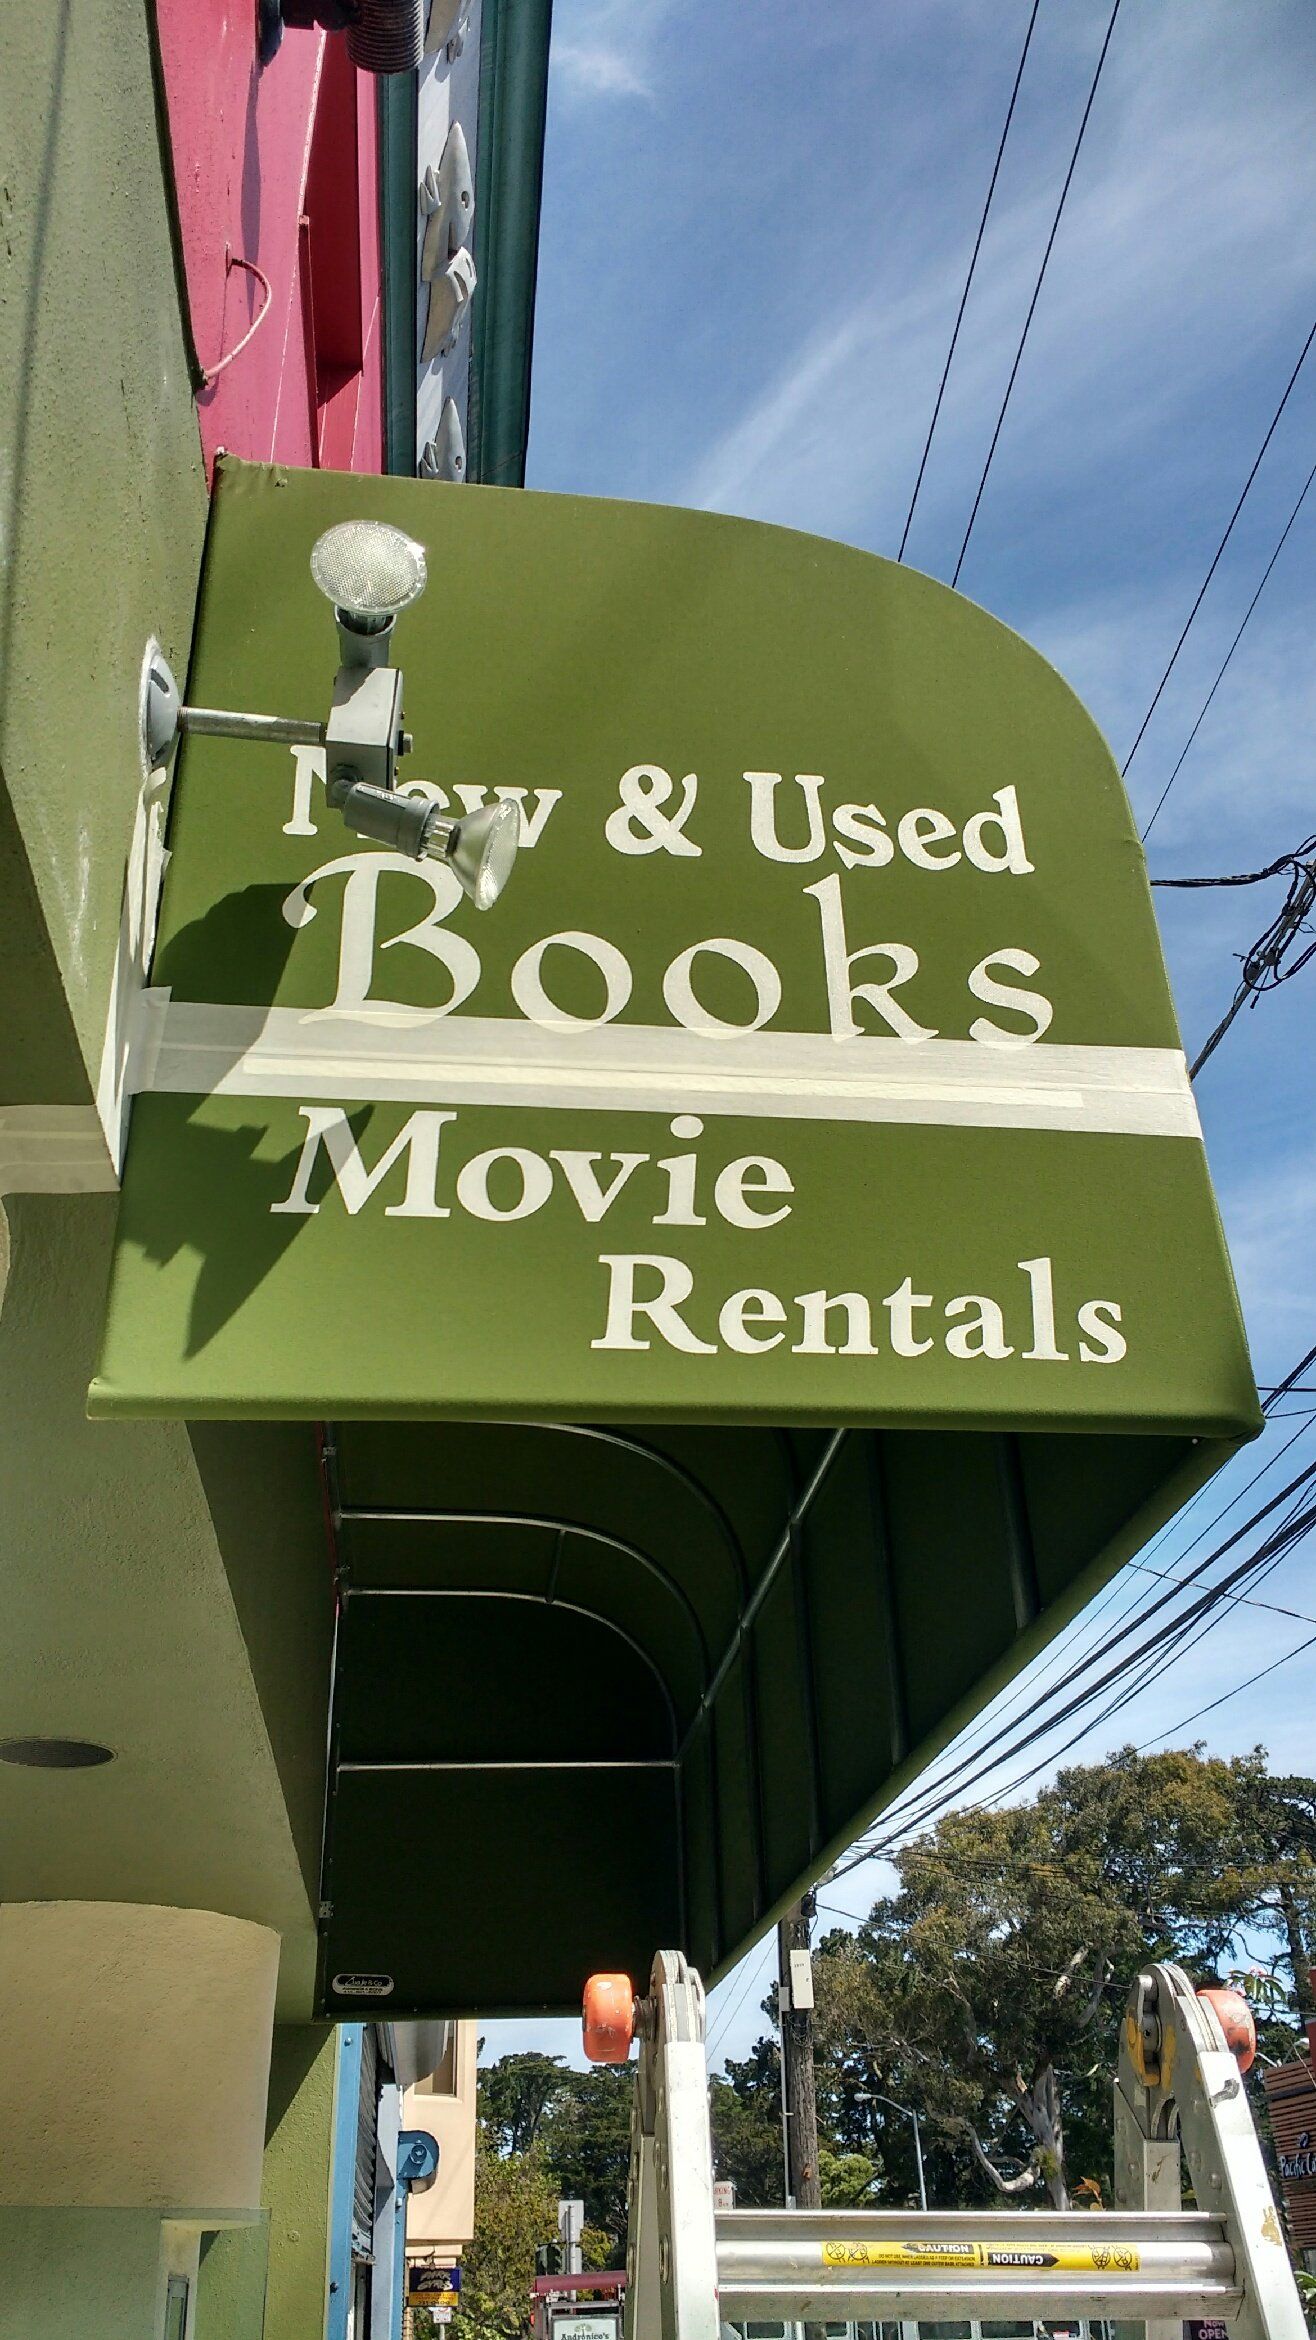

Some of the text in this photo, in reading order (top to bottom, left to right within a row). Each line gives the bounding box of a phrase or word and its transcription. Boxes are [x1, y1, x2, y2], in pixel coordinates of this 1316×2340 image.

[605, 764, 703, 857] &
[742, 771, 1036, 875] Used
[282, 851, 1054, 1051] Books
[270, 1105, 796, 1230] Movie
[590, 1253, 1128, 1364] Rentals
[917, 2243, 969, 2253] CAUTION
[992, 2253, 1044, 2265] CAUTION
[1198, 2328, 1228, 2340] OPEN
